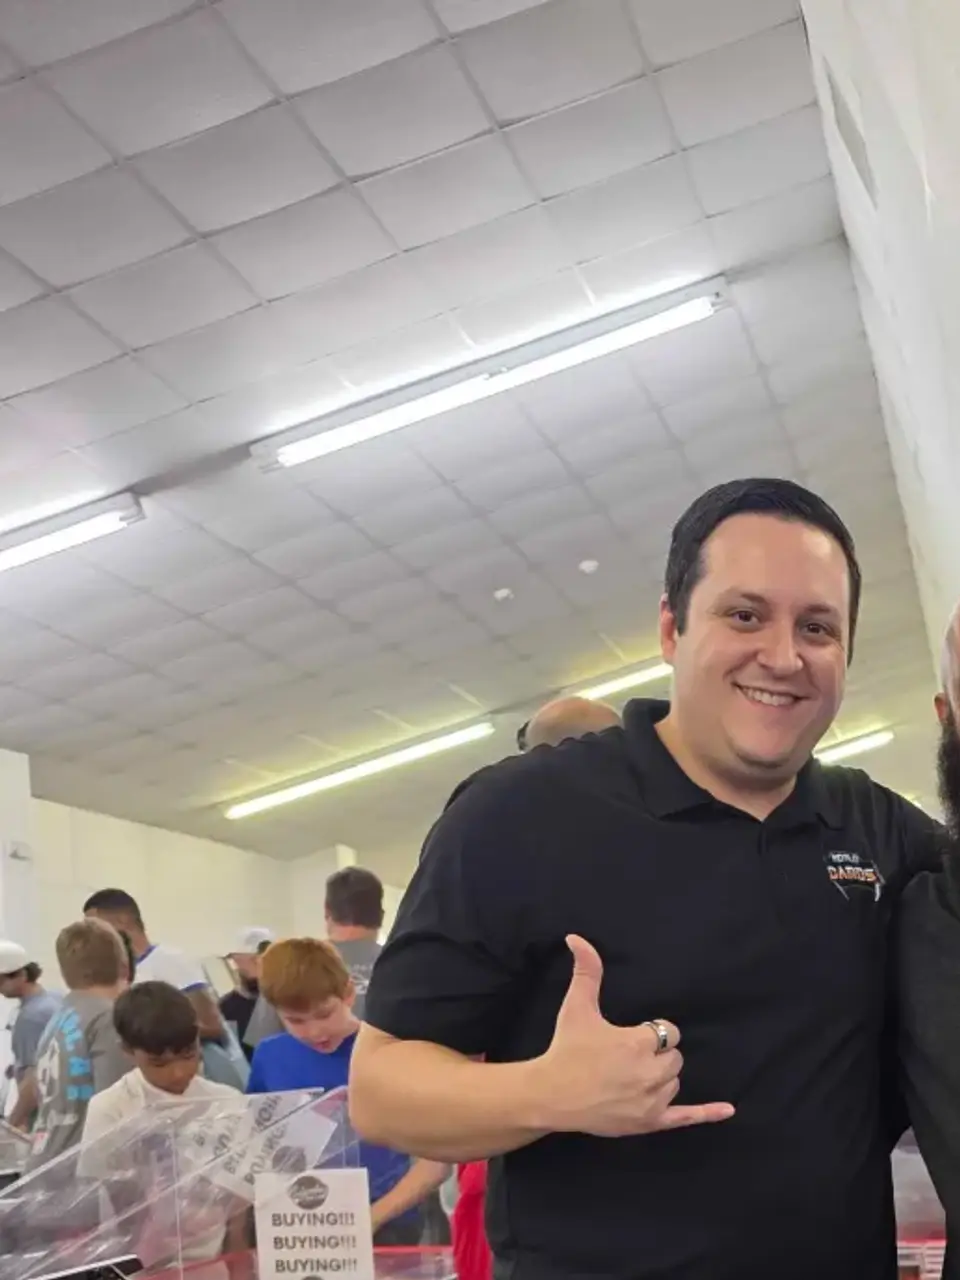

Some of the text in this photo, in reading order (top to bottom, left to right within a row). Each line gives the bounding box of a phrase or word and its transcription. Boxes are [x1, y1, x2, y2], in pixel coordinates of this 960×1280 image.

[827, 865, 878, 882] CARDS
[270, 1211, 356, 1228] BUYING!!!
[272, 1235, 357, 1251] BUYING!!!
[274, 1258, 358, 1274] BUYING!!!
